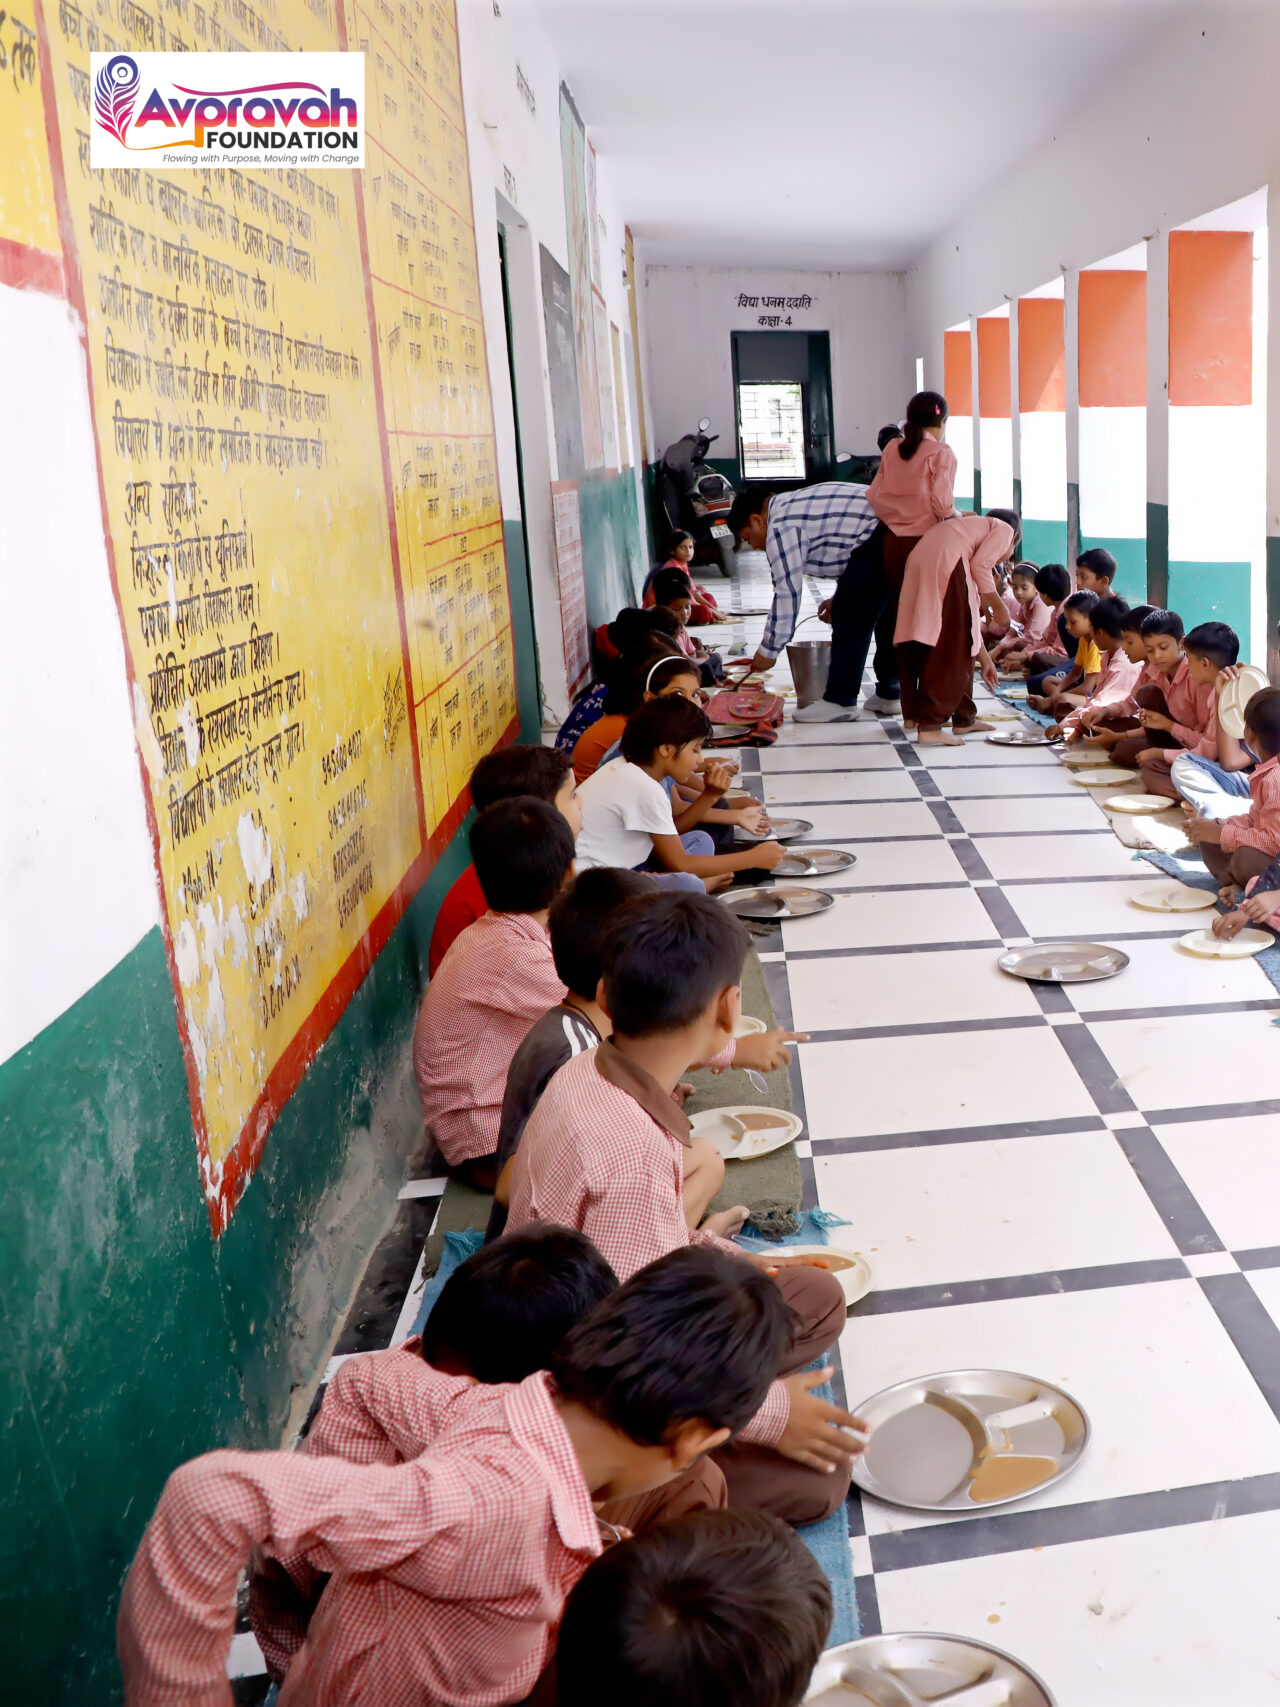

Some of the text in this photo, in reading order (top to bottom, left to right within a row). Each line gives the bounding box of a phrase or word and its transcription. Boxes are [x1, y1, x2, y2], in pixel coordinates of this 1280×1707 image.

[737, 293, 813, 312] विद्या धनम् ददाति
